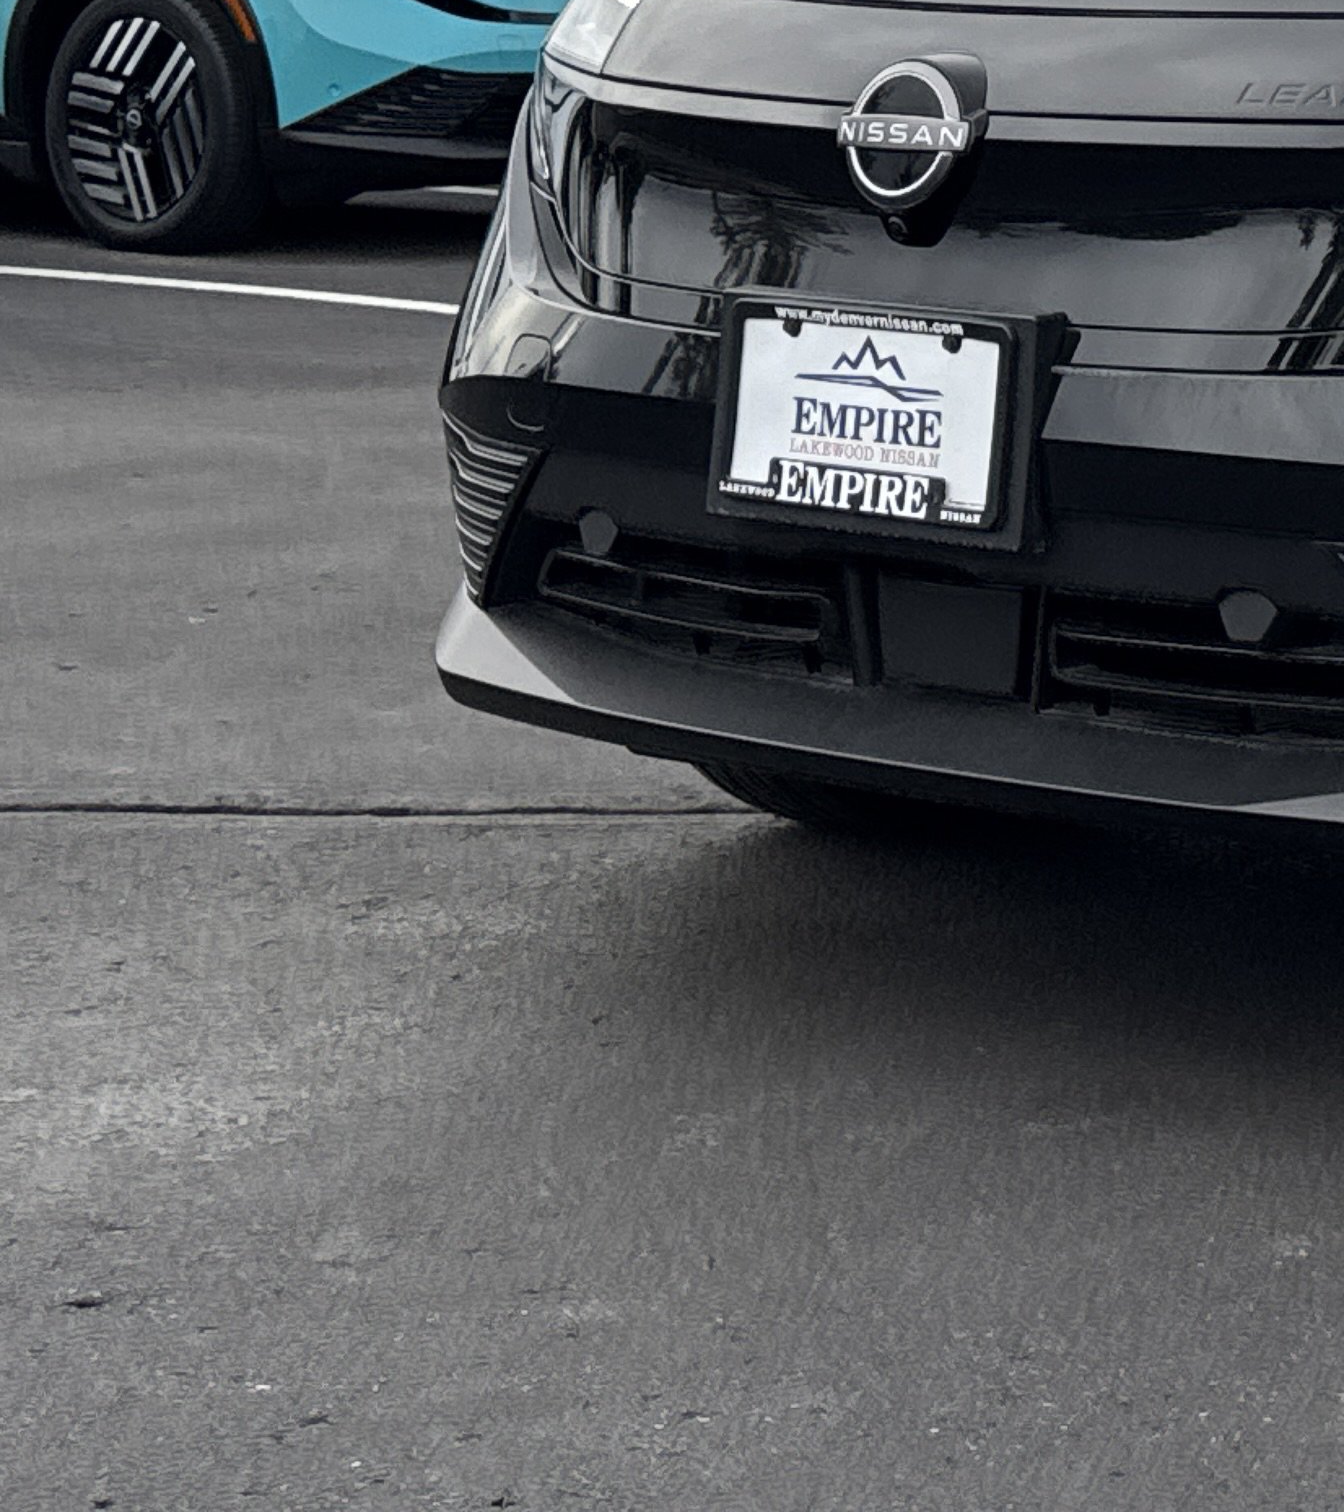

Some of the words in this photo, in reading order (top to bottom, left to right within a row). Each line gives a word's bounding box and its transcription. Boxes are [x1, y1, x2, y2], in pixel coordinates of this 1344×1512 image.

[839, 120, 964, 148] NISSAN
[775, 306, 963, 335] www.mydenvernissan.com
[791, 397, 942, 448] EMPIRE
[789, 438, 875, 461] LAKEWOOD
[879, 446, 941, 469] NISSAN
[776, 460, 929, 519] EMPIRE
